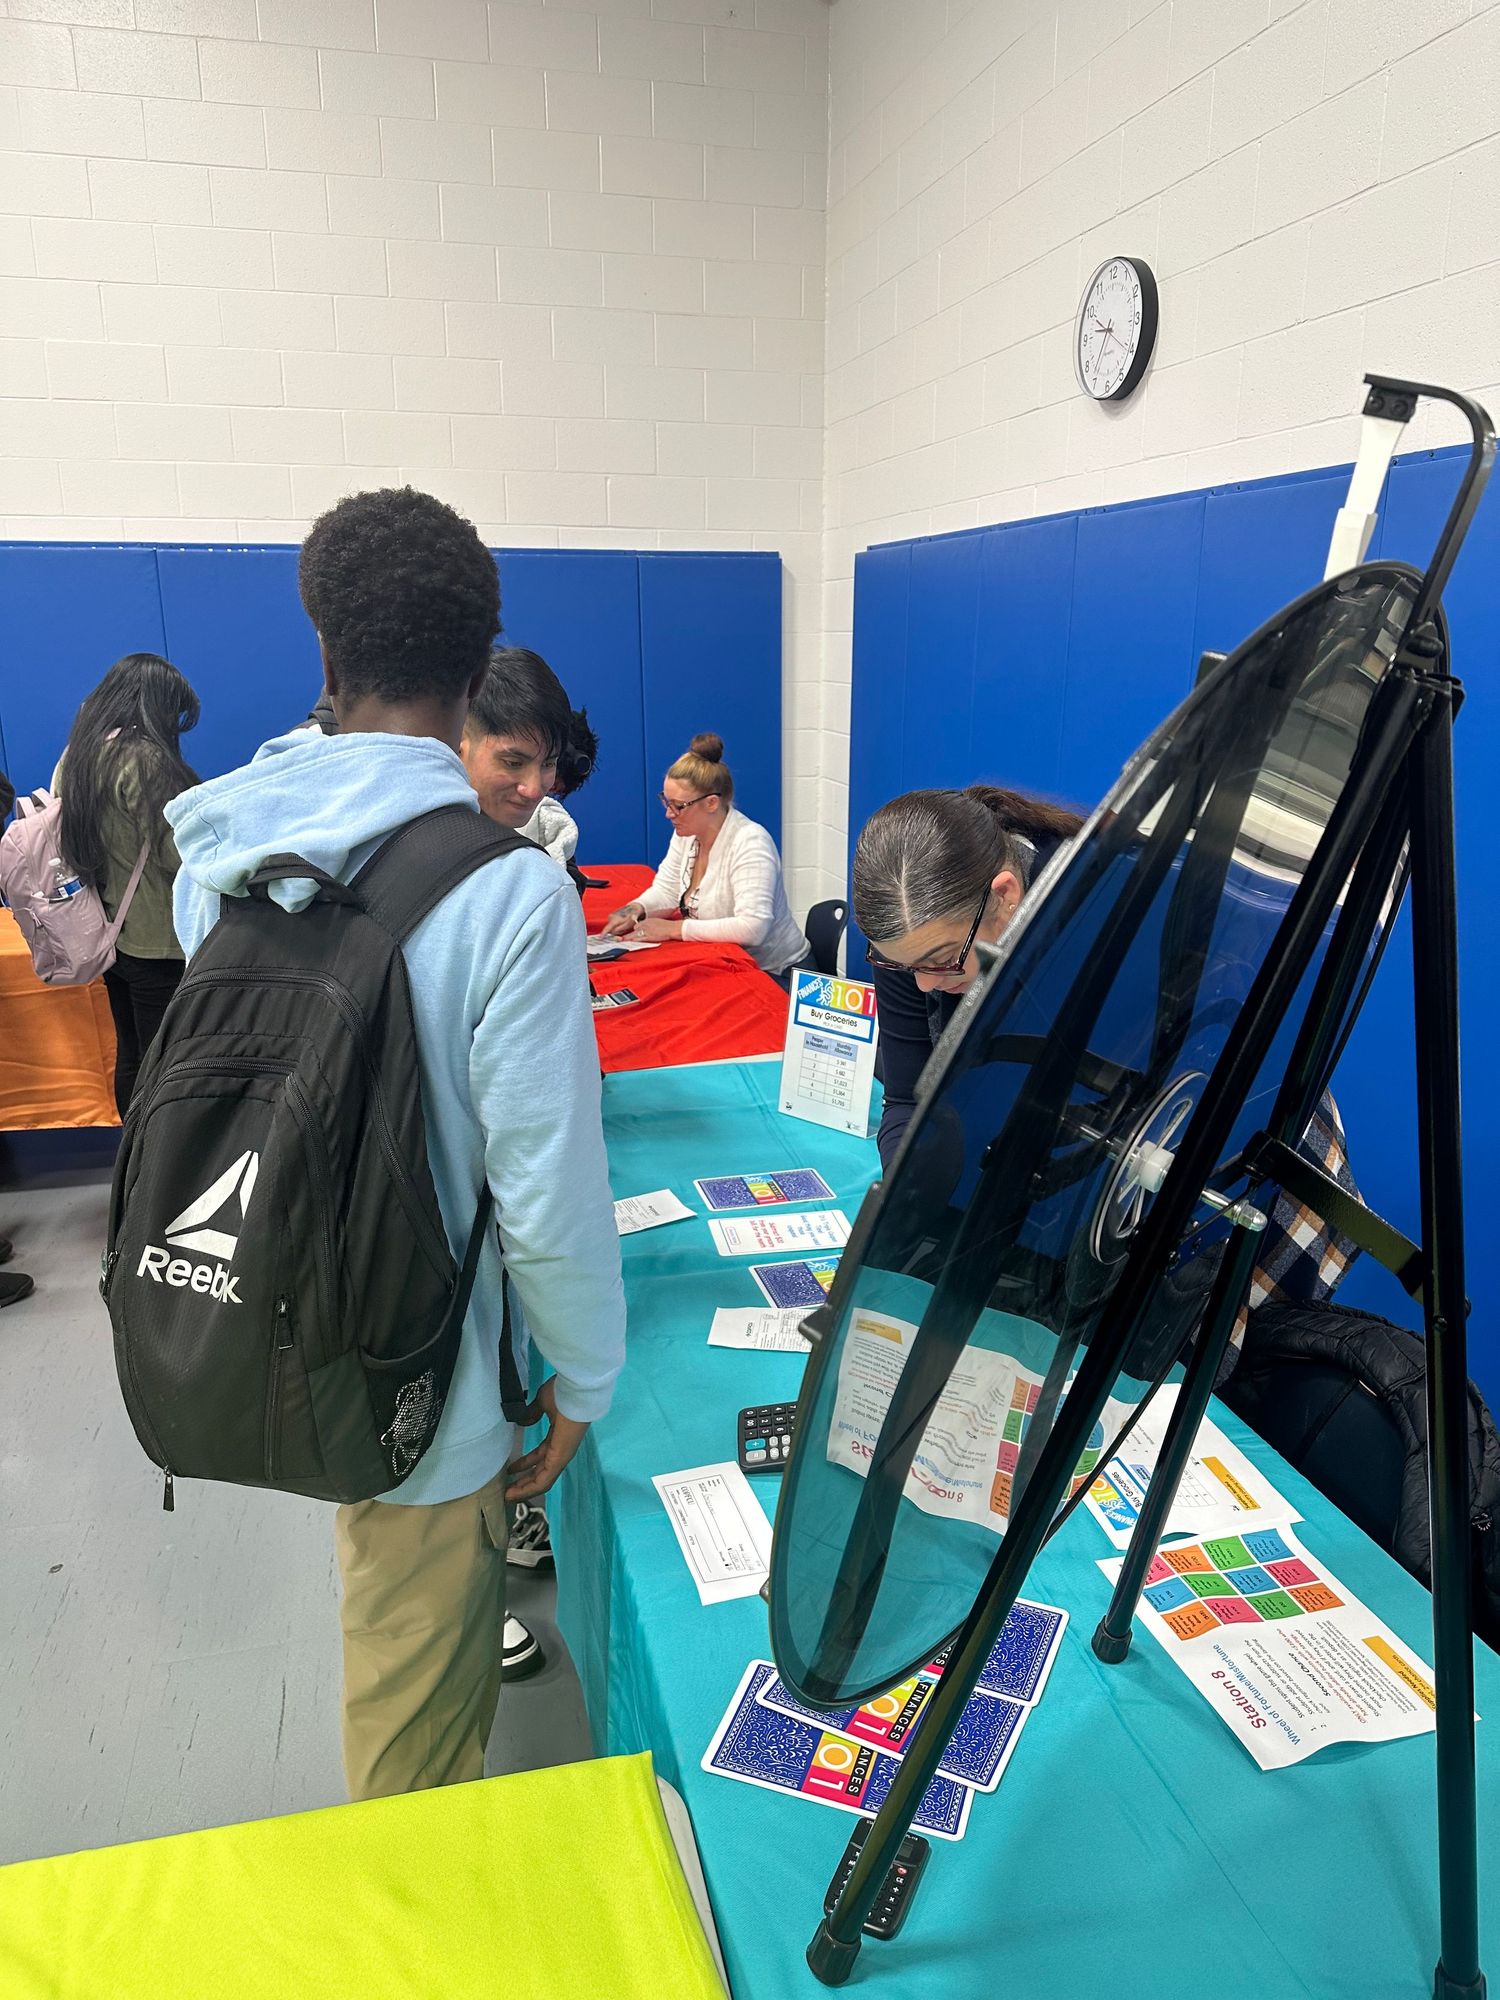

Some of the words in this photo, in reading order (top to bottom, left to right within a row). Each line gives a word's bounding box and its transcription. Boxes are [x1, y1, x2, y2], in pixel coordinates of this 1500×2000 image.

[835, 985, 876, 1014] 101
[810, 1009, 822, 1019] Buy
[825, 1012, 858, 1027] Groceries
[136, 1244, 243, 1303] Reebk
[1112, 1471, 1133, 1497] Groceries
[1243, 1652, 1257, 1666] wheel
[1288, 1652, 1309, 1673] Chance
[1211, 1670, 1225, 1679] 8
[1211, 1643, 1271, 1710] Fortune/Misfortune
[1256, 1665, 1271, 1678] game
[1267, 1678, 1276, 1687] the
[1275, 1687, 1289, 1699] spins
[1306, 1673, 1330, 1696] Second
[889, 1682, 929, 1741] FINANCES
[1220, 1680, 1269, 1728] Station
[1266, 1710, 1280, 1718] of
[1284, 1698, 1304, 1718] Student
[1275, 1719, 1300, 1744] Wheel
[848, 1747, 872, 1794] ANCES
